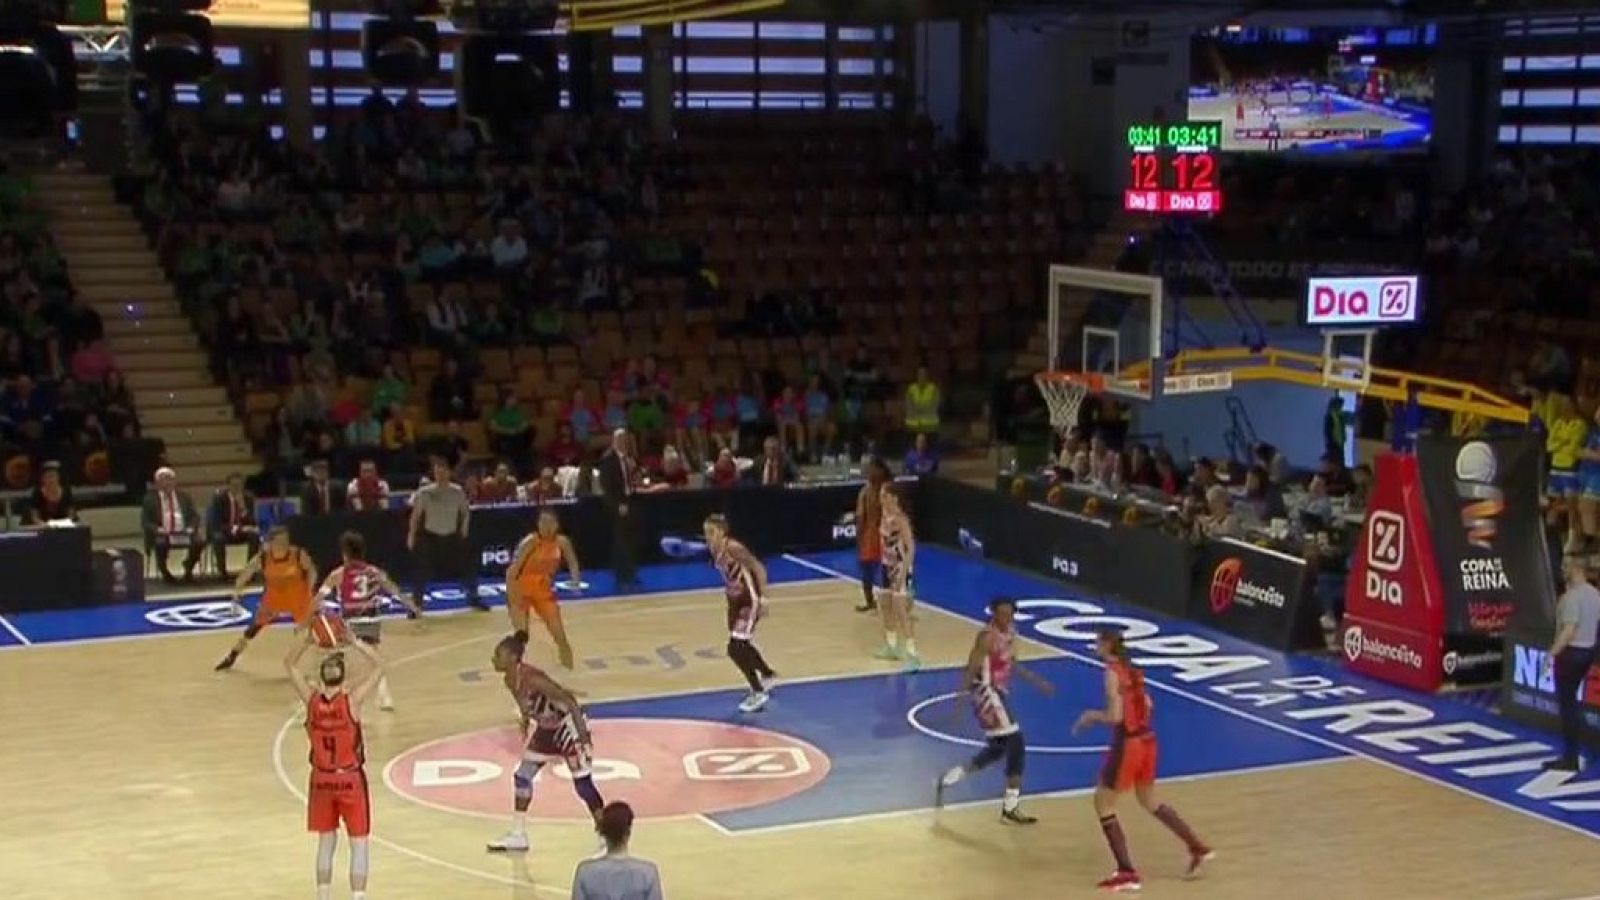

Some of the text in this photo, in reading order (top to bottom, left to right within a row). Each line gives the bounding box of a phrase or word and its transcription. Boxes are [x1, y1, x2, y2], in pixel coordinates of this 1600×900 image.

[1168, 125, 1218, 145] 03:41
[1131, 154, 1158, 189] 12
[1171, 154, 1214, 189] 12
[1314, 286, 1369, 316] Dia
[832, 524, 858, 540] PG
[482, 550, 511, 566] PG
[1460, 558, 1495, 573] COPA
[351, 574, 368, 599] 3
[1366, 569, 1403, 606] Dia
[1462, 572, 1512, 591] REINA
[985, 599, 1271, 682] COPA
[1210, 682, 1298, 707] LA
[1271, 675, 1367, 699] DE
[322, 735, 337, 765] 4
[1284, 699, 1600, 811] REIN
[412, 760, 641, 787] Da
